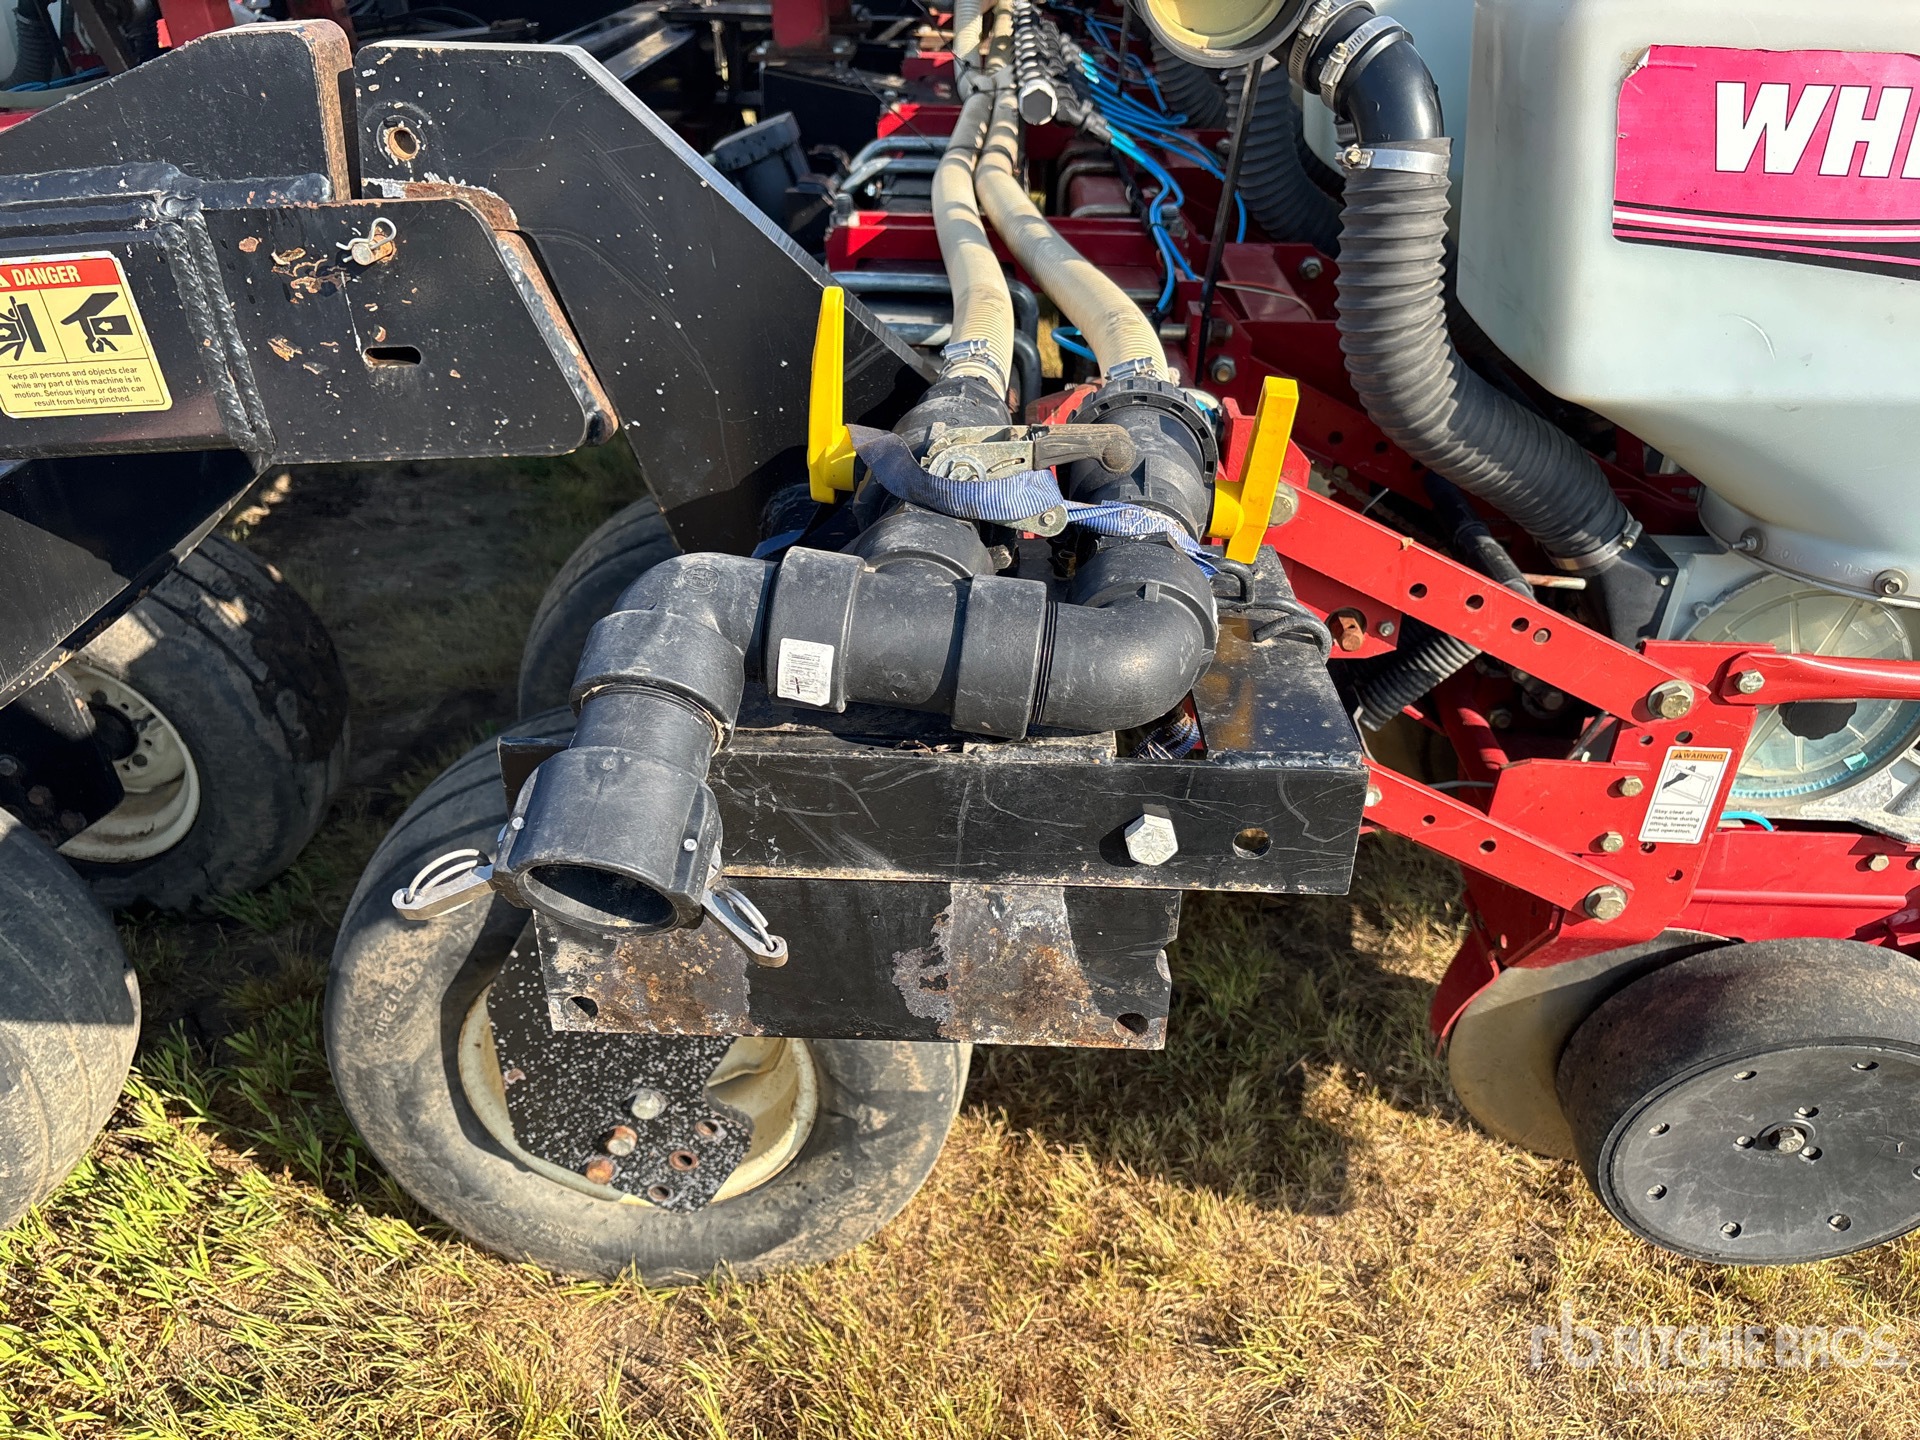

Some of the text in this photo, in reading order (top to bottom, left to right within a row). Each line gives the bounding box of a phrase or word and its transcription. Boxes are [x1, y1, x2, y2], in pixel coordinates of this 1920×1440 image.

[11, 265, 81, 286] DANGER
[40, 371, 70, 379] persons
[88, 368, 117, 377] objects
[119, 366, 137, 374] clear
[12, 381, 31, 389] while
[49, 380, 63, 388] part
[91, 377, 123, 385] machine
[15, 390, 43, 398] motion.
[45, 389, 73, 397] Serious
[75, 387, 96, 396] injury
[107, 385, 129, 393] death
[57, 397, 74, 405] from
[76, 396, 97, 404] being
[99, 395, 132, 403] pinched.
